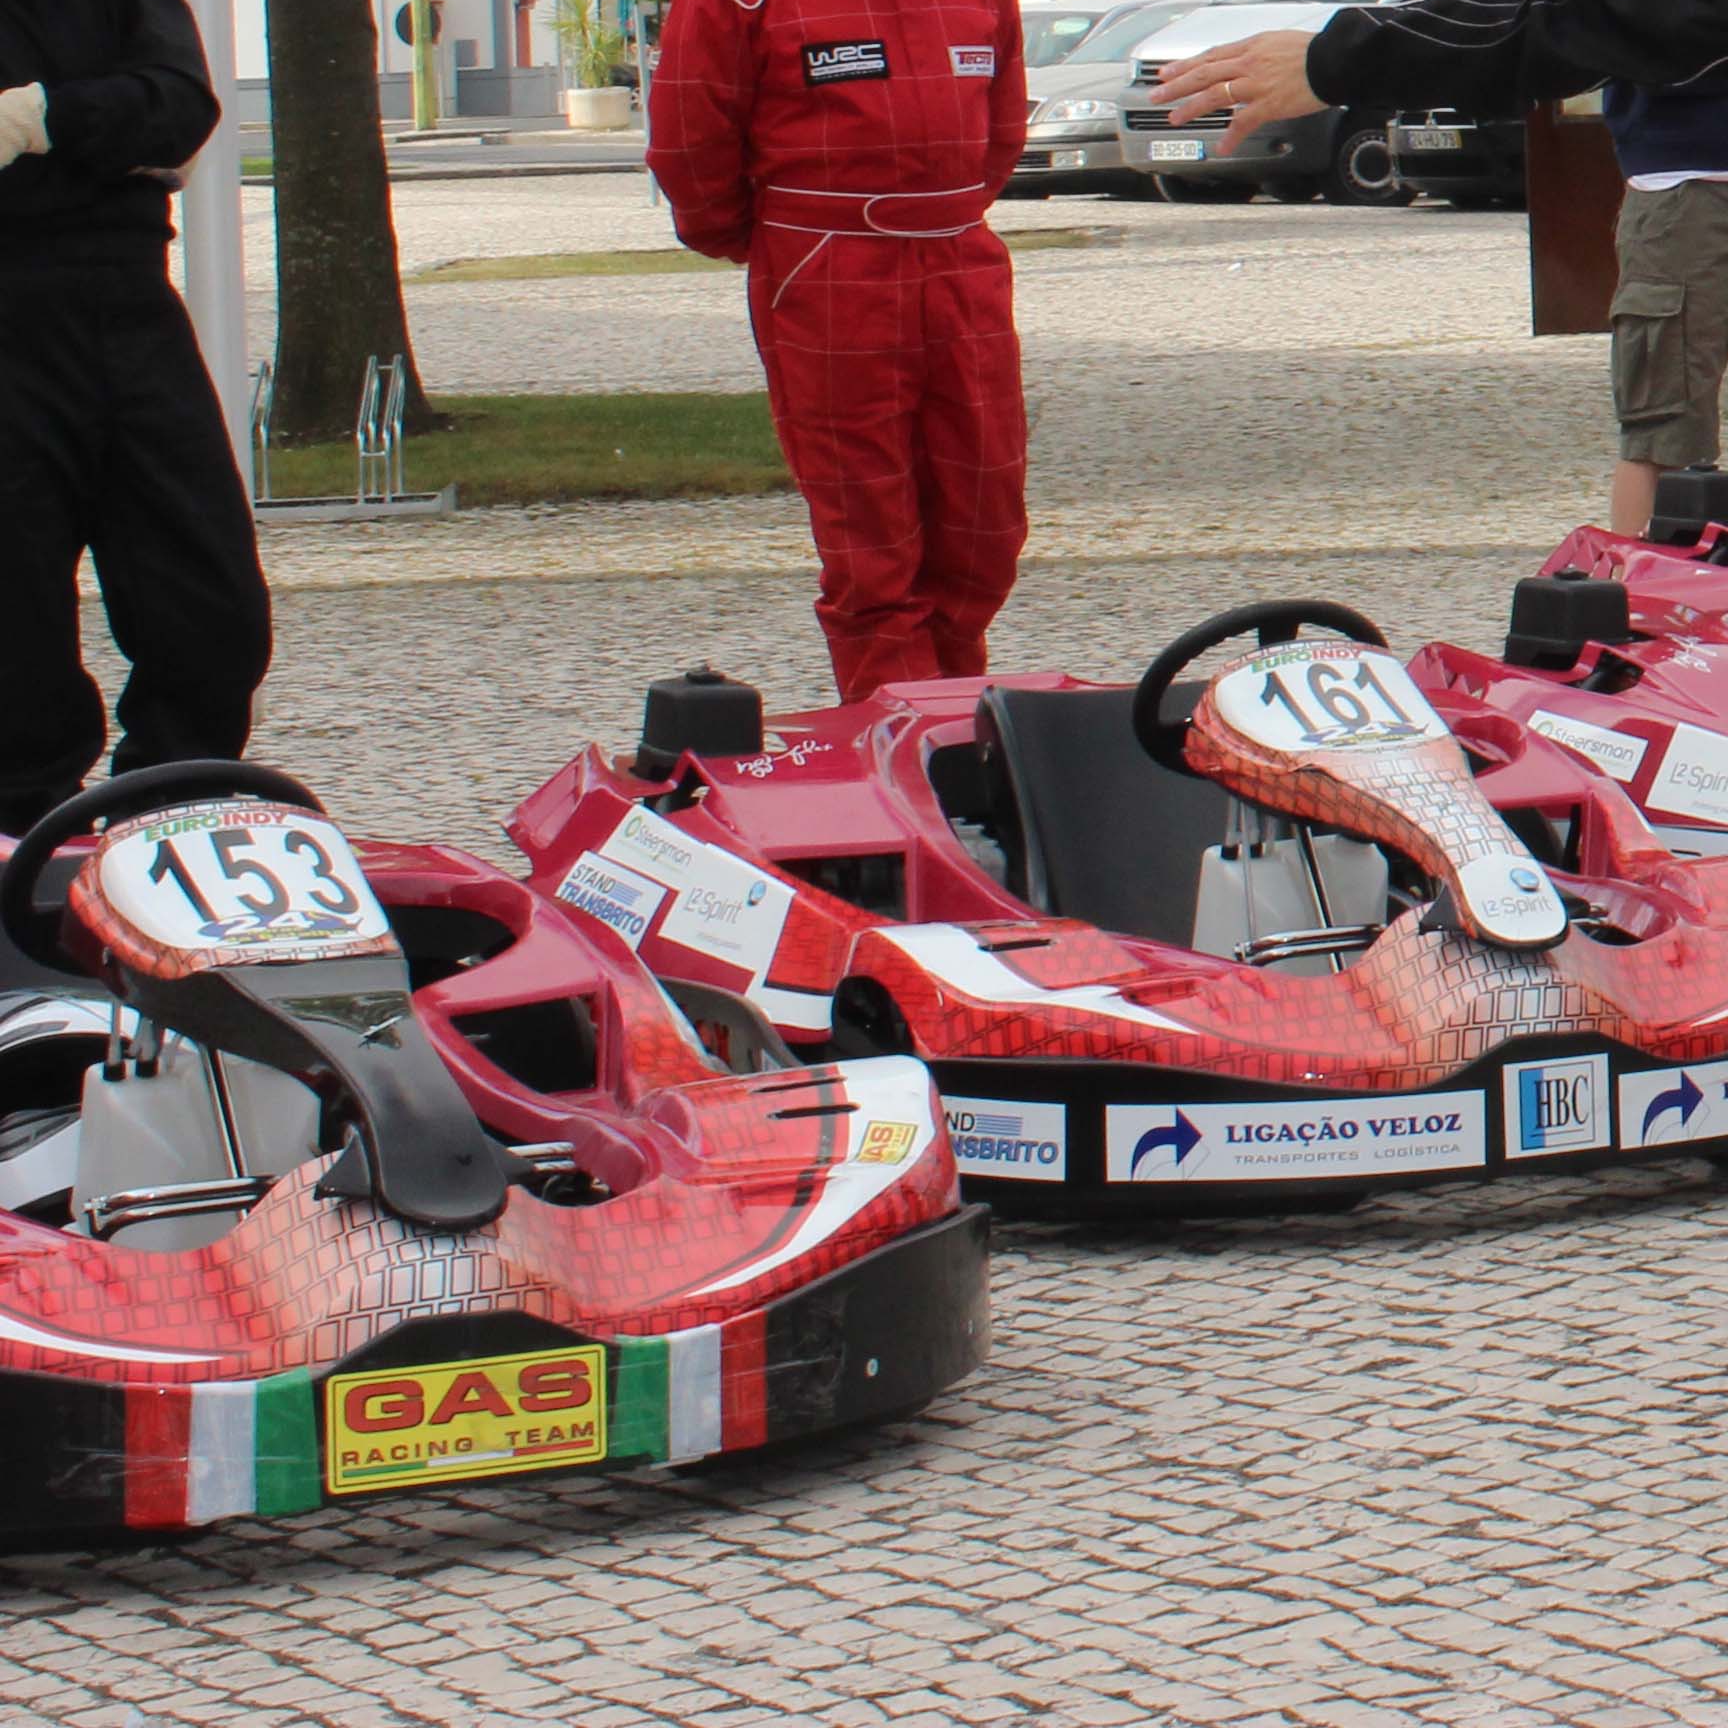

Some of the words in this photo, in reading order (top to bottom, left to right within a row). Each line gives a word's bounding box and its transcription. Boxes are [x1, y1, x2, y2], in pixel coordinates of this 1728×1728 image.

[808, 43, 882, 67] WRC
[1252, 647, 1362, 672] EUROINDY
[1259, 662, 1413, 734] 161
[1551, 726, 1635, 762] Steersman
[144, 811, 290, 843] EUROINDY
[635, 823, 693, 868] Steersman
[147, 828, 361, 924] 153
[570, 863, 617, 895] STAND
[558, 882, 646, 936] TRANSBRITO
[697, 890, 743, 926] Spirit
[1500, 895, 1554, 917] Spirit
[1534, 1074, 1590, 1130] HBC
[1225, 1115, 1359, 1149] LIGAÇÃO
[1367, 1113, 1463, 1139] VELOZ
[951, 1136, 1059, 1166] NSBRITO
[1233, 1149, 1360, 1167] TRANSPORTES
[1373, 1143, 1462, 1160] LOGÍSTICA
[344, 1359, 594, 1435] GAS
[341, 1436, 474, 1467] RACING
[504, 1421, 596, 1447] TEAM
